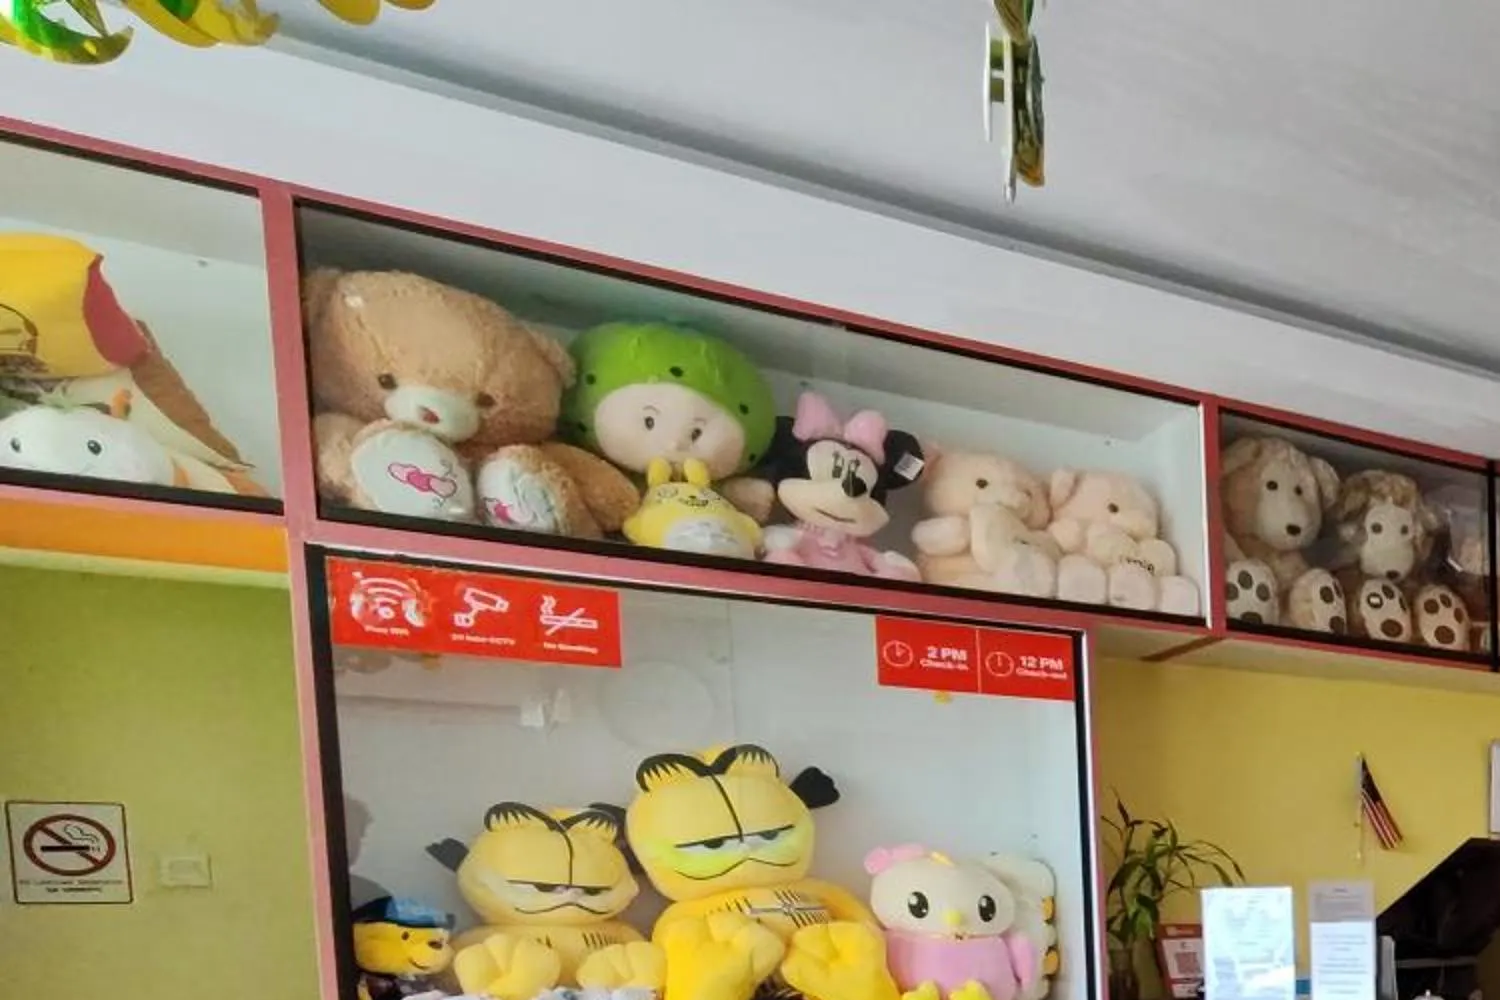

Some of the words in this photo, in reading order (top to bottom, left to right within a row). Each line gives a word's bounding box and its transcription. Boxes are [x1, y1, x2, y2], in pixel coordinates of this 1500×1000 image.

[927, 645, 937, 659] 2
[940, 647, 968, 662] PM
[1019, 655, 1037, 669] 12
[1039, 656, 1065, 671] PM
